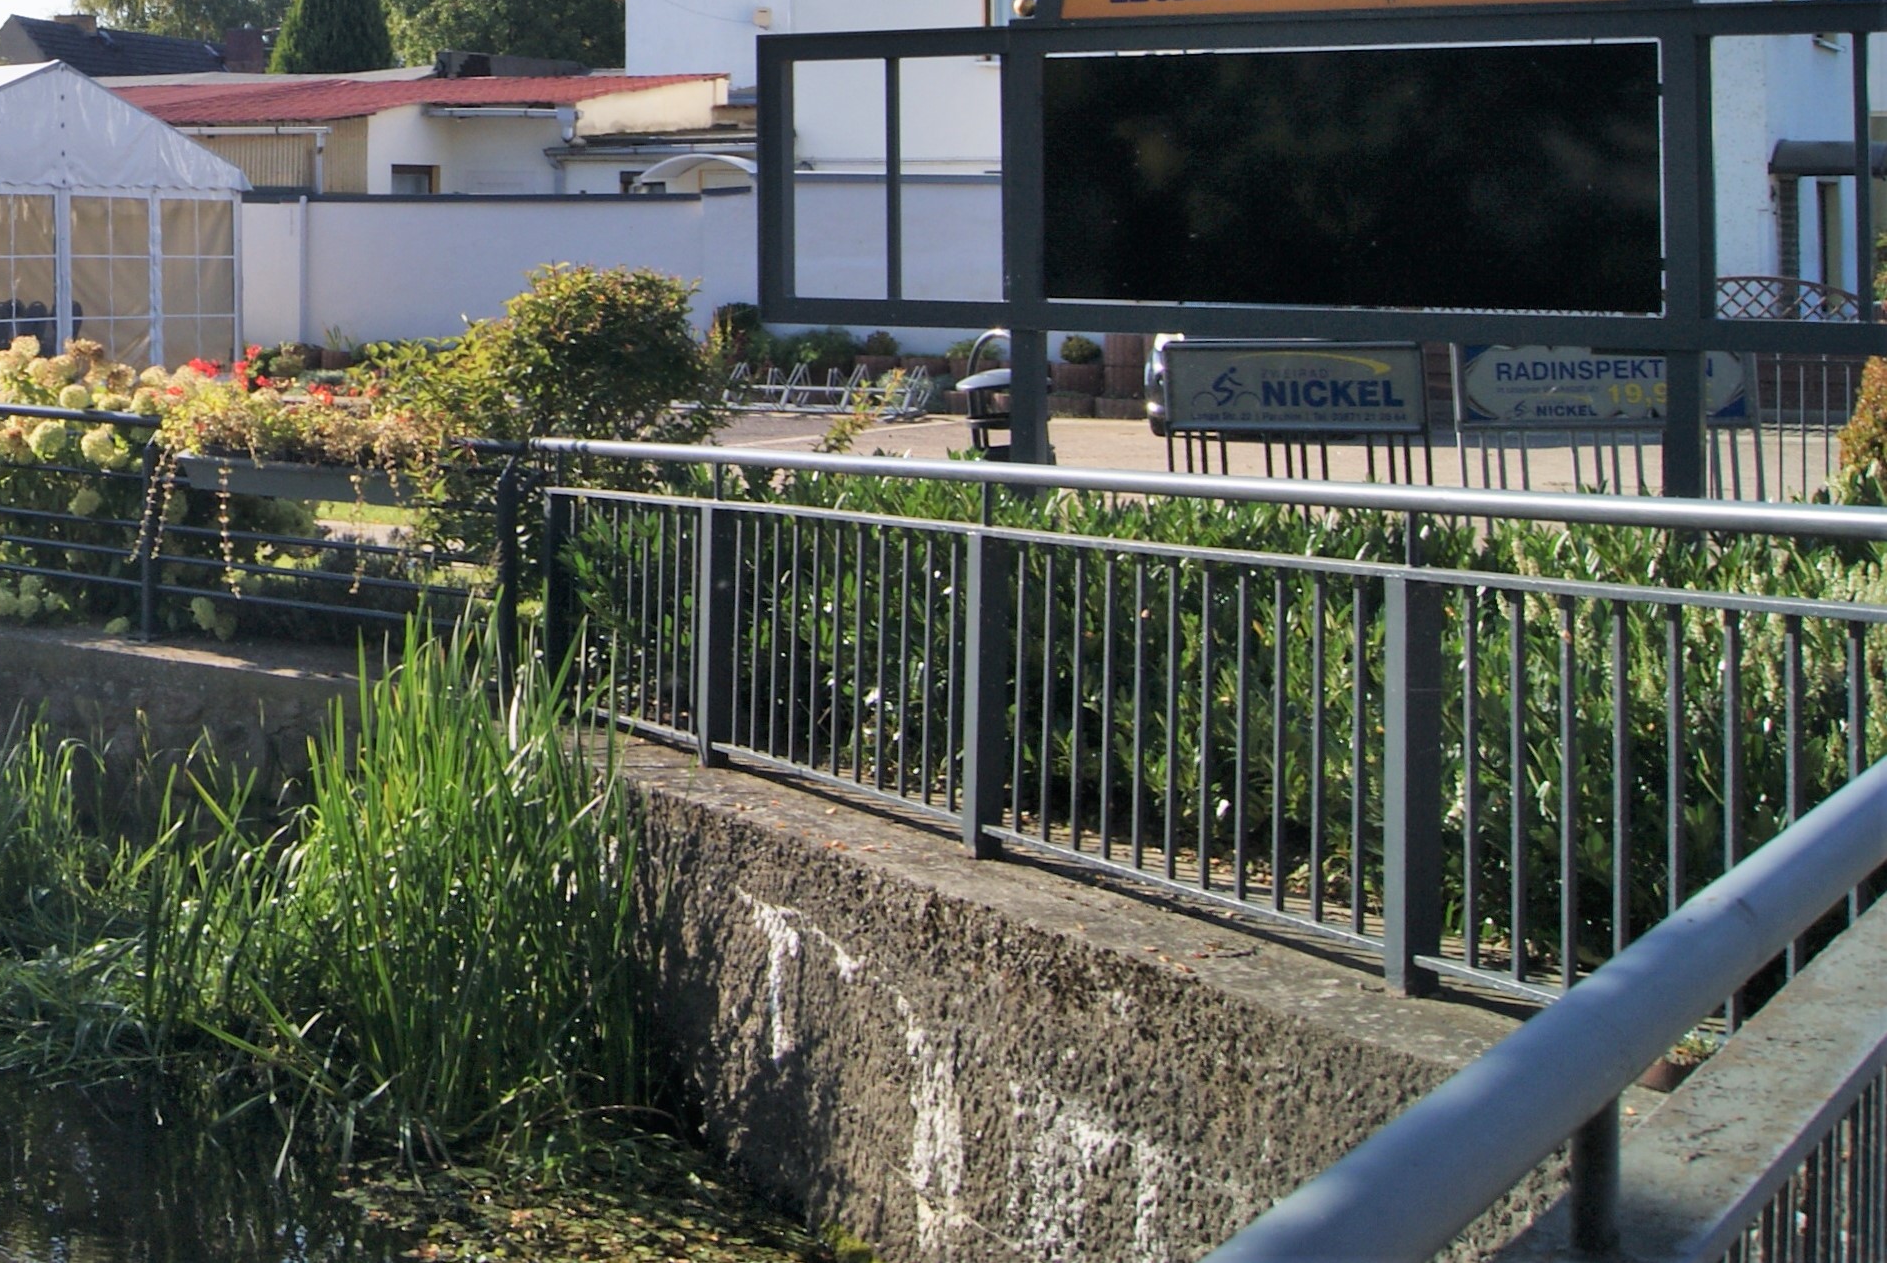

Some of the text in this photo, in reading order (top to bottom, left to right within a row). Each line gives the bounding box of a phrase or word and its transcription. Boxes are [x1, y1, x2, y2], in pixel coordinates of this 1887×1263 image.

[1496, 358, 1713, 381] RADINSPEKT
[1262, 379, 1404, 408] NICKEL
[1536, 404, 1598, 417] NICKEL
